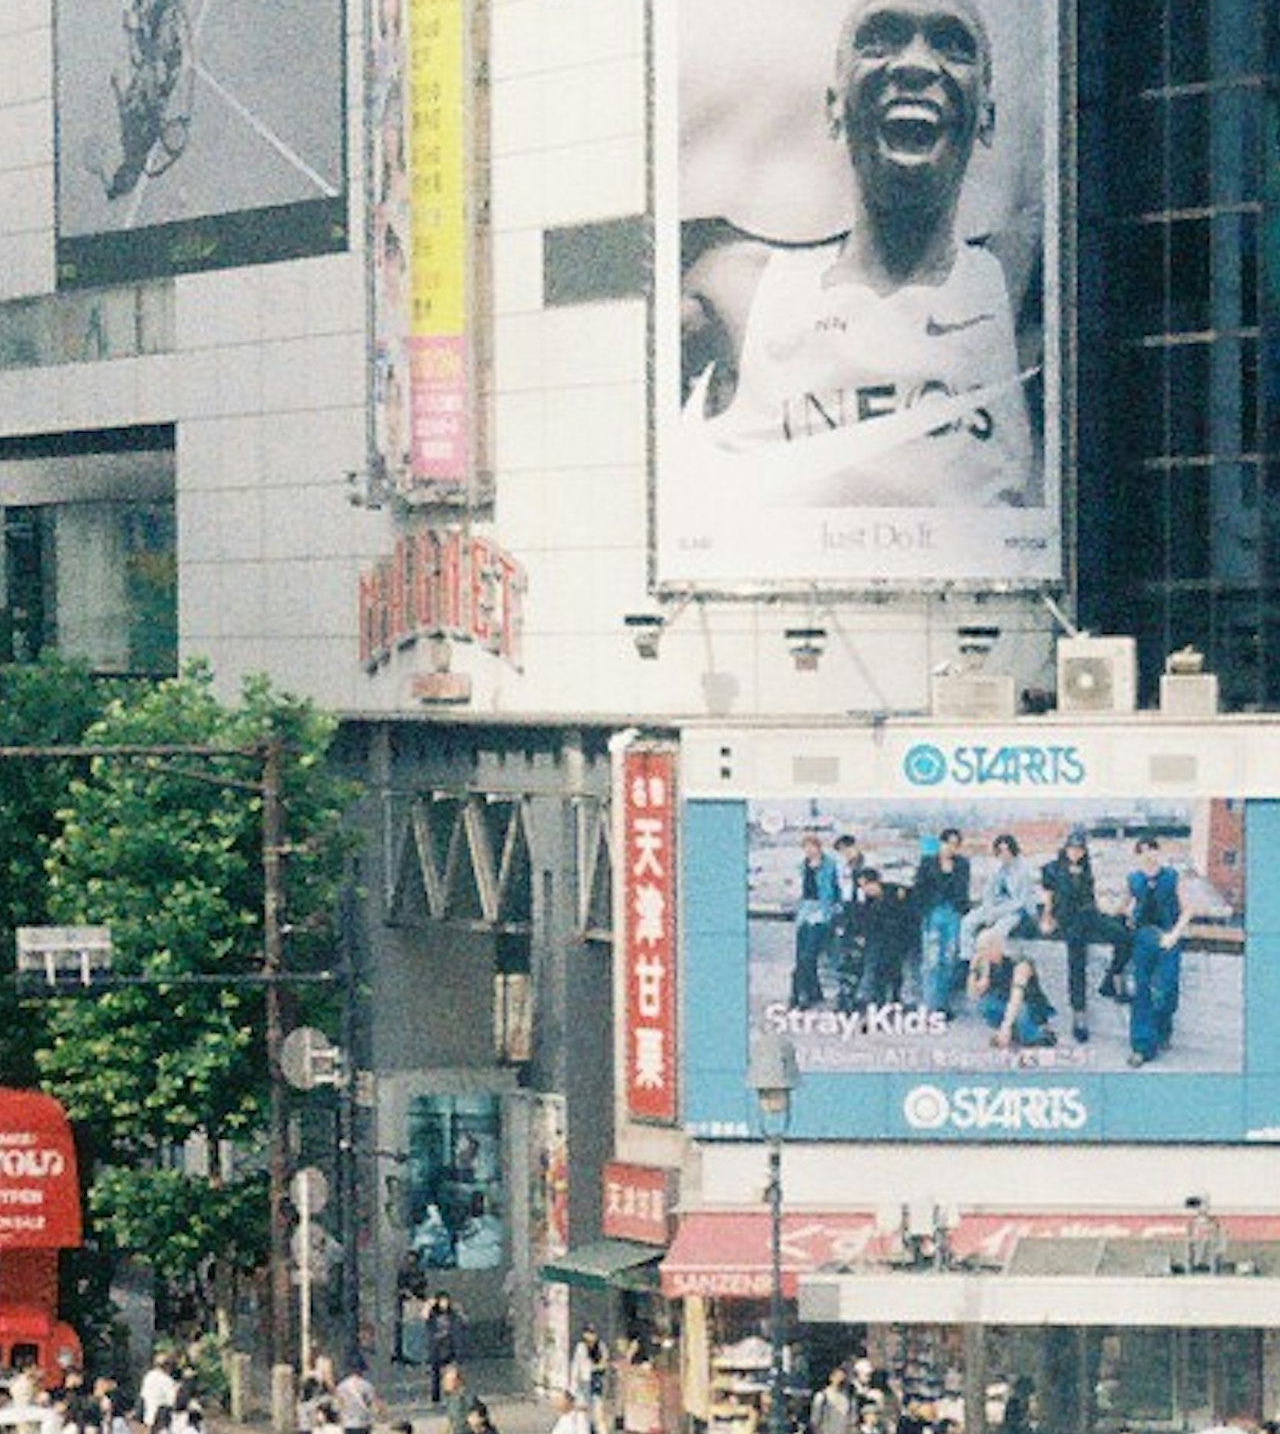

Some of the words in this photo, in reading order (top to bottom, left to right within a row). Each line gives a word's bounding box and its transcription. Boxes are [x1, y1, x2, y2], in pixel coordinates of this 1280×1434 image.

[951, 744, 1087, 786] STARTS
[766, 1002, 863, 1042] Stray
[865, 1002, 948, 1035] Kids
[951, 1086, 1088, 1129] STARTS
